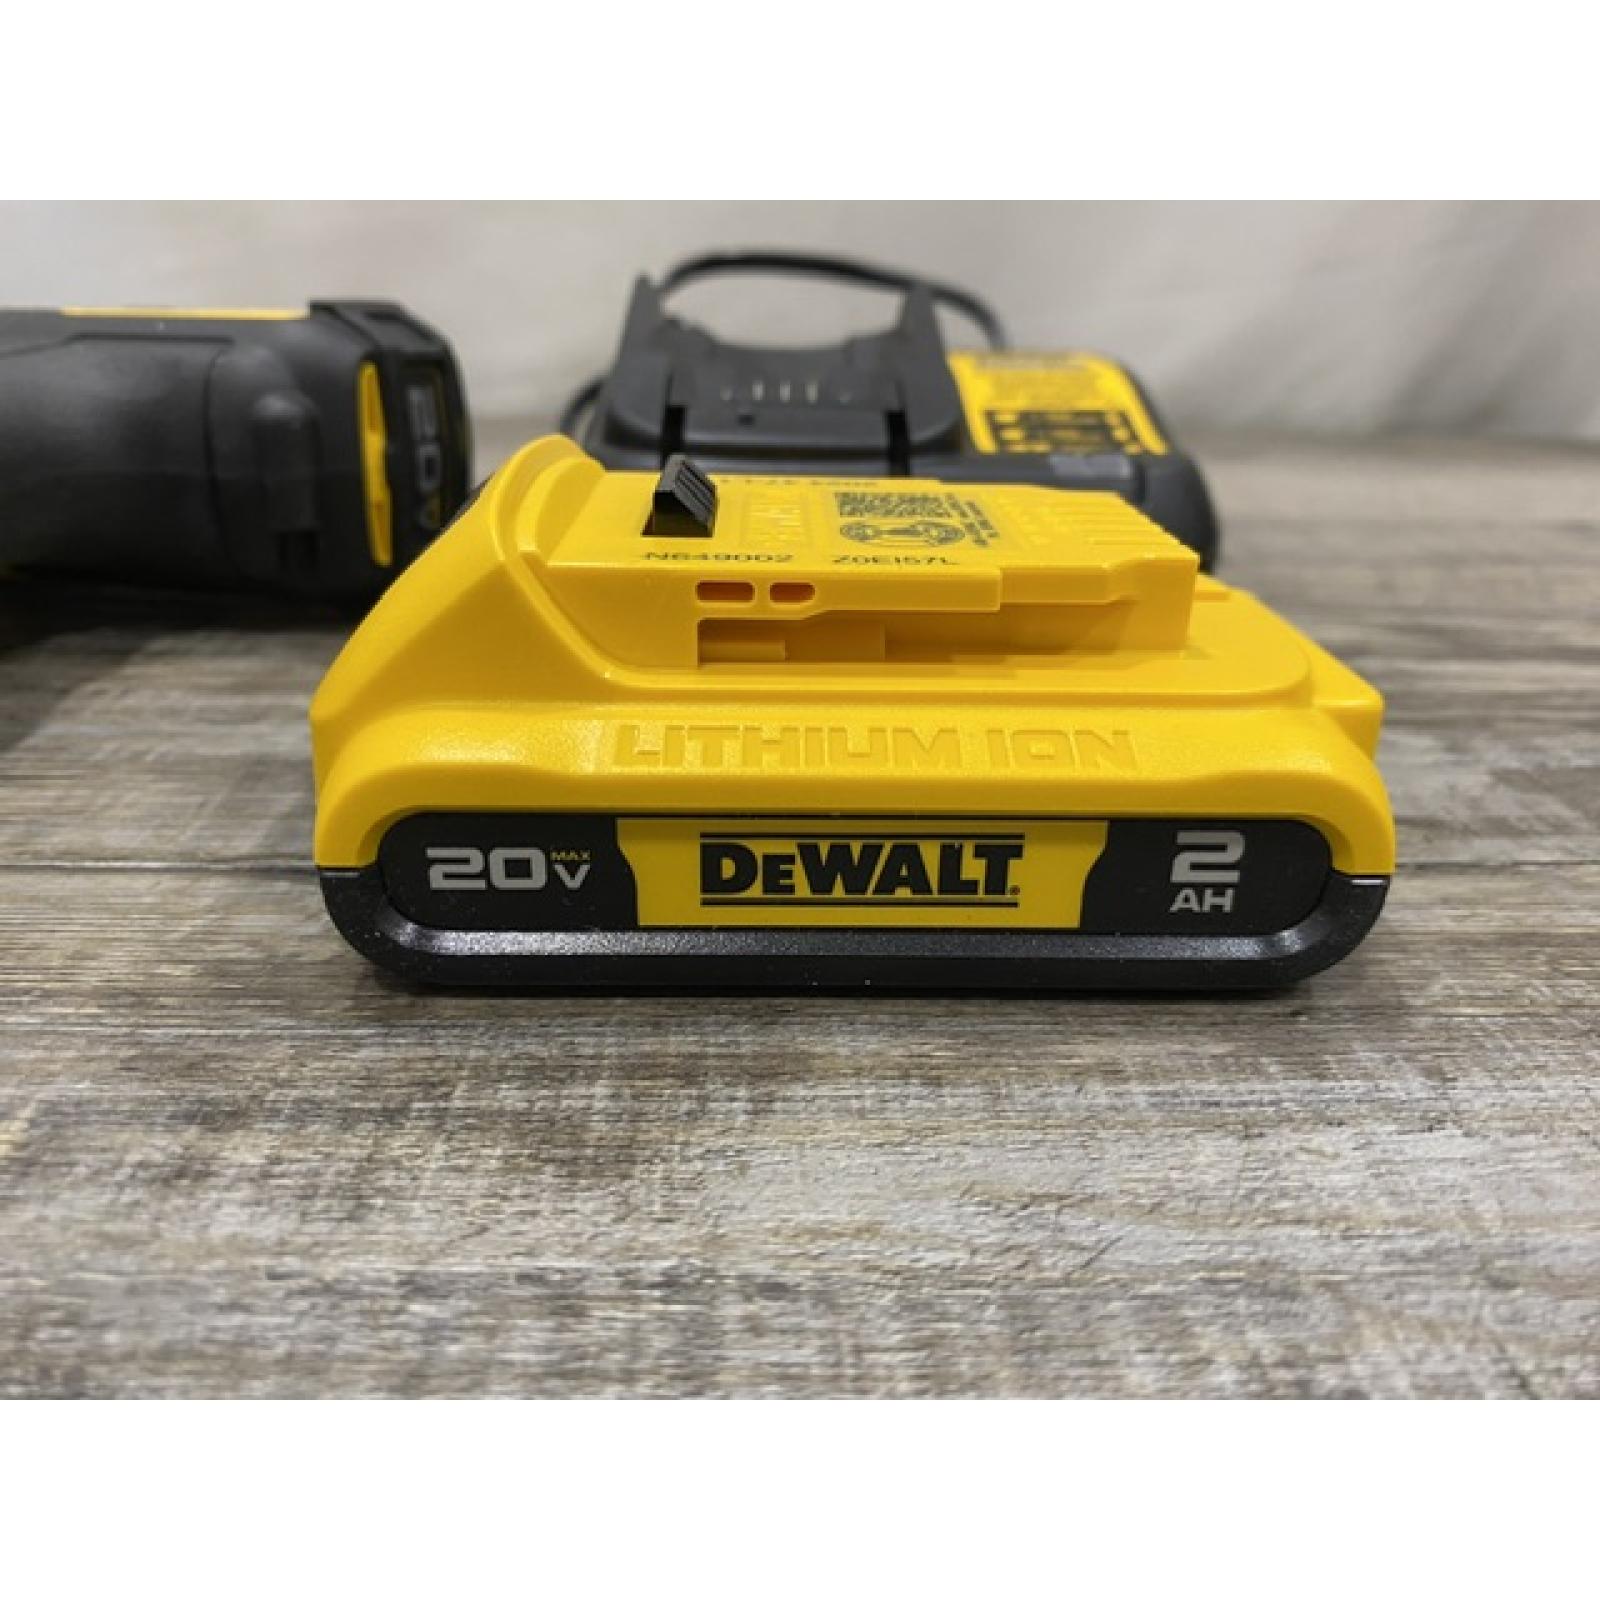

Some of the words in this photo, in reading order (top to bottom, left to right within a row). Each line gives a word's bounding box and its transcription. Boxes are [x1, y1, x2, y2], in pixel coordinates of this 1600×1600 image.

[612, 724, 964, 769] LITHIUM
[986, 729, 1138, 771] ION
[1170, 829, 1245, 883] 2
[1169, 887, 1234, 913] AH
